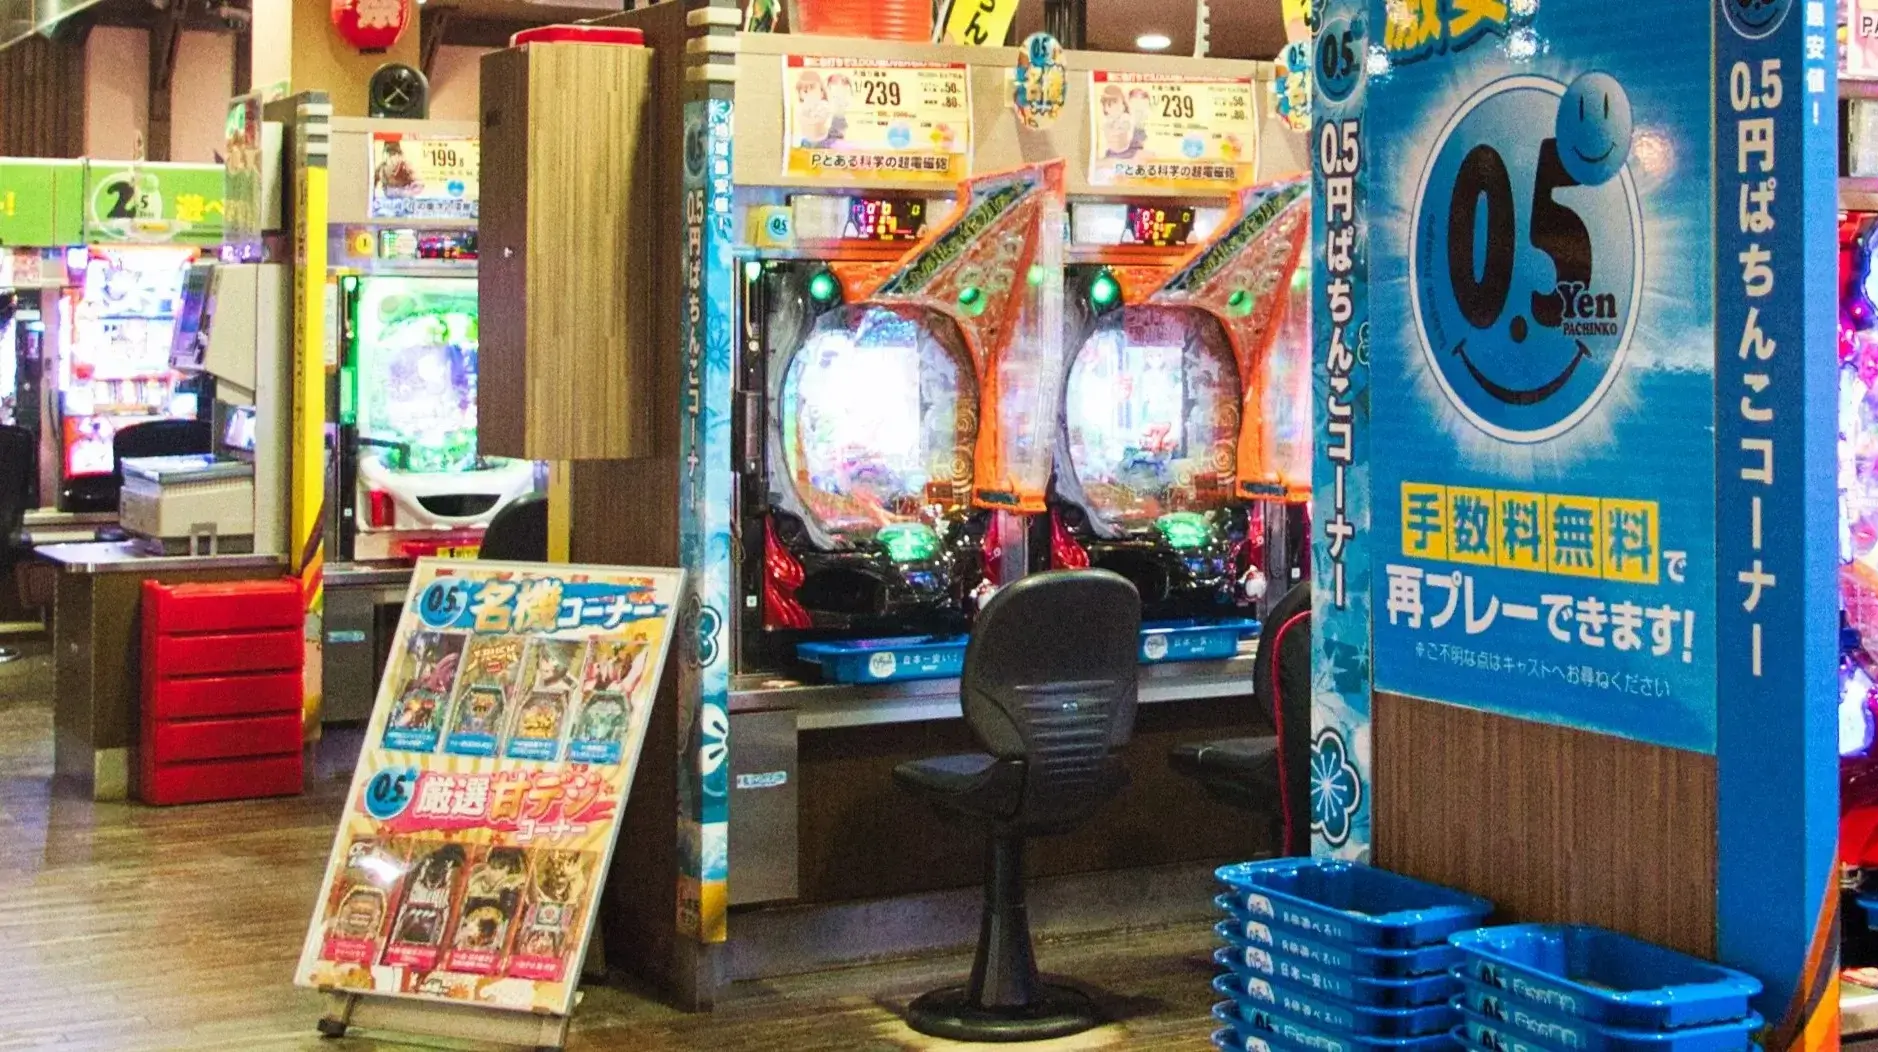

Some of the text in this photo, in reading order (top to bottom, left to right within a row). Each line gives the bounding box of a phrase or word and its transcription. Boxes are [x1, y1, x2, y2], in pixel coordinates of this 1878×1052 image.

[1319, 122, 1360, 609] 0.5円ぱちんこコーナー
[1557, 283, 1618, 321] Yen
[1562, 322, 1619, 337] PACHINKO
[1729, 58, 1783, 678] 0.5円ぱちんこコーナー
